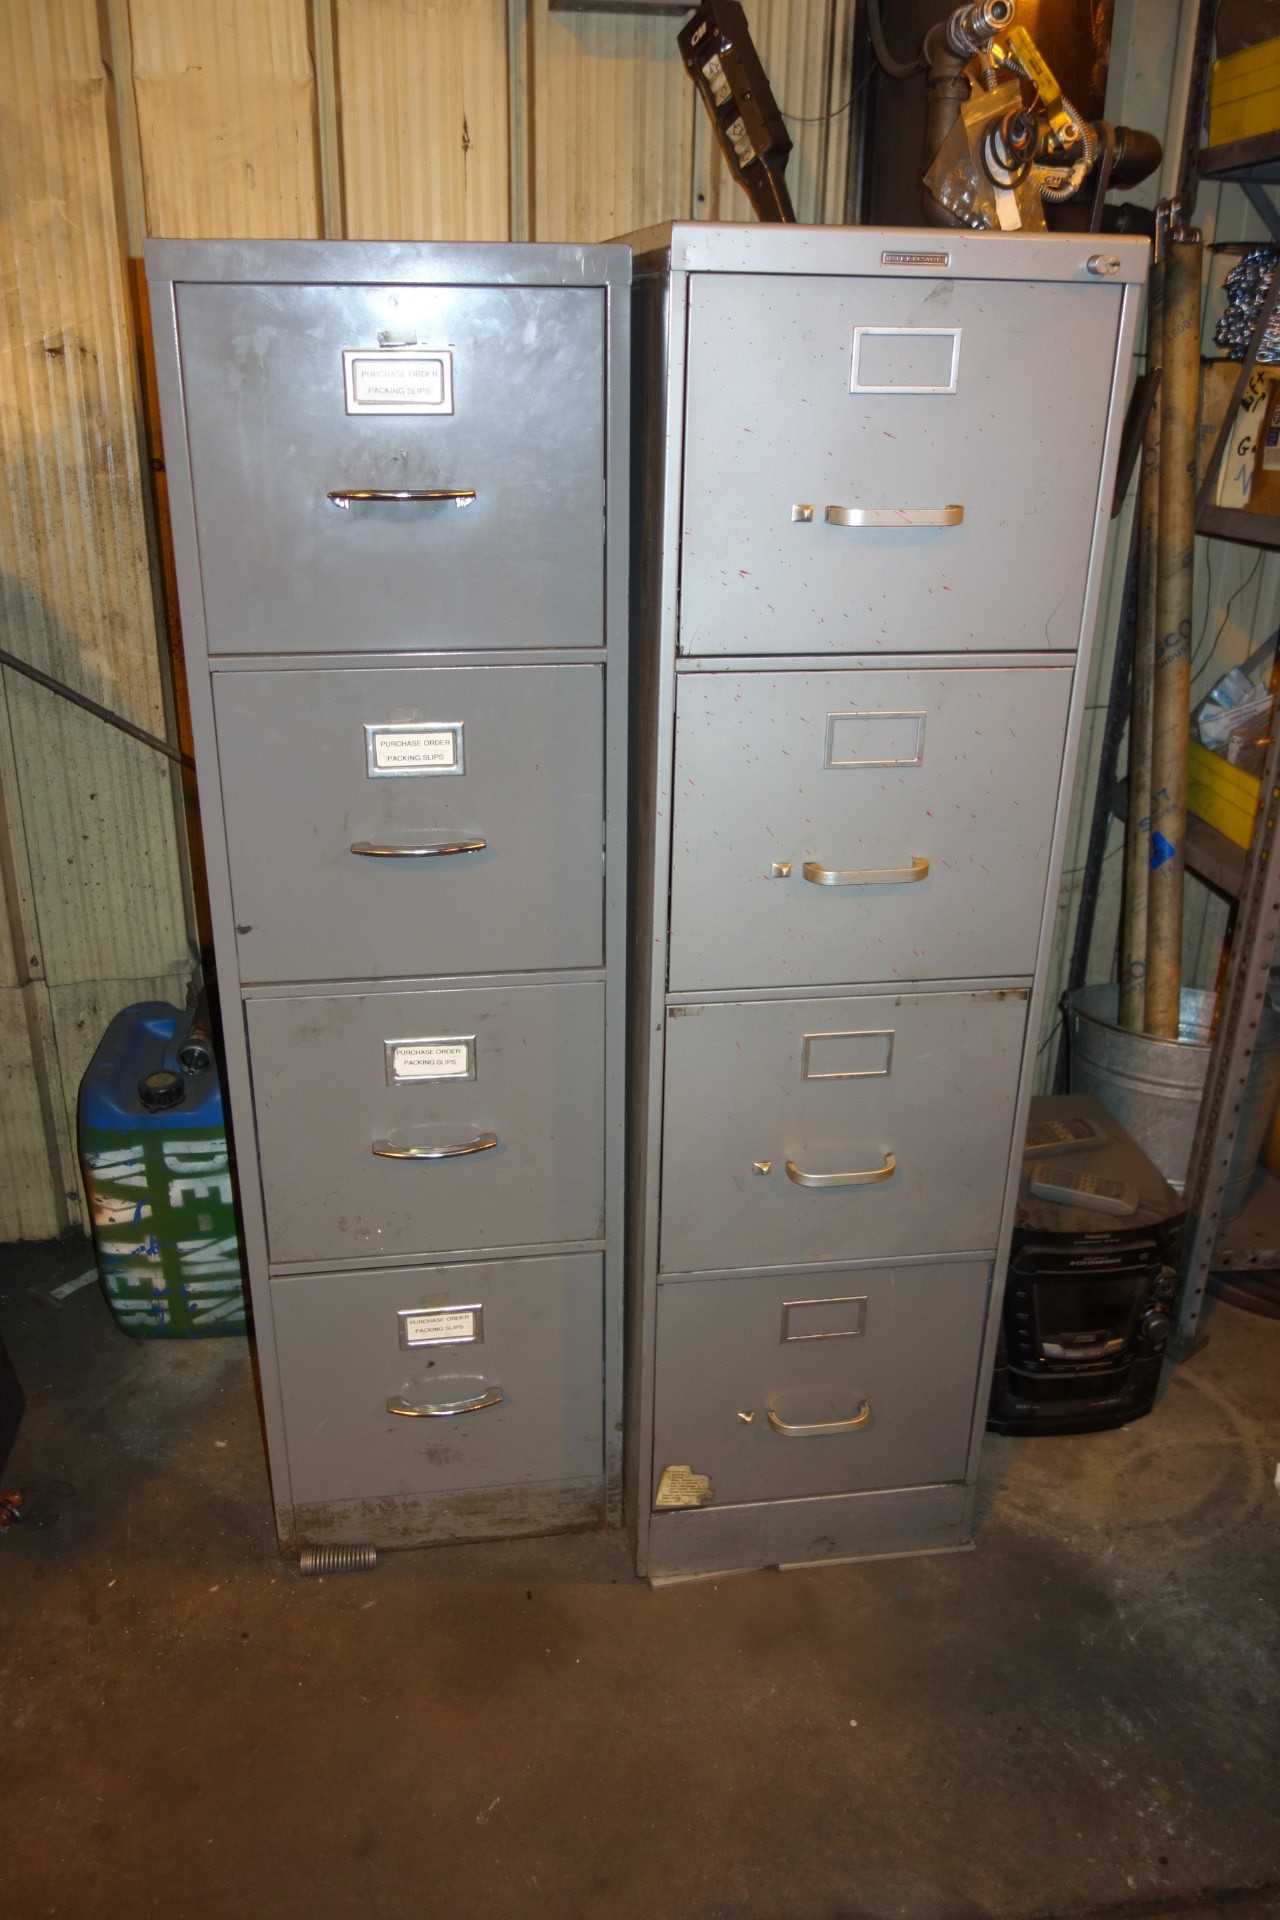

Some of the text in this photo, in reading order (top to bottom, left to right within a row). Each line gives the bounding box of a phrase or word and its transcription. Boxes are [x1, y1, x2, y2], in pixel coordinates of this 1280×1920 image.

[361, 367, 404, 377] PURCHASE
[368, 384, 432, 395] PACKING SLIPS
[380, 740, 420, 748] PURCHASE
[396, 1048, 434, 1056] PURCHASE
[84, 1144, 171, 1327] WATER
[163, 1138, 246, 1326] DE-MIN
[409, 1317, 444, 1325] PURCHASE
